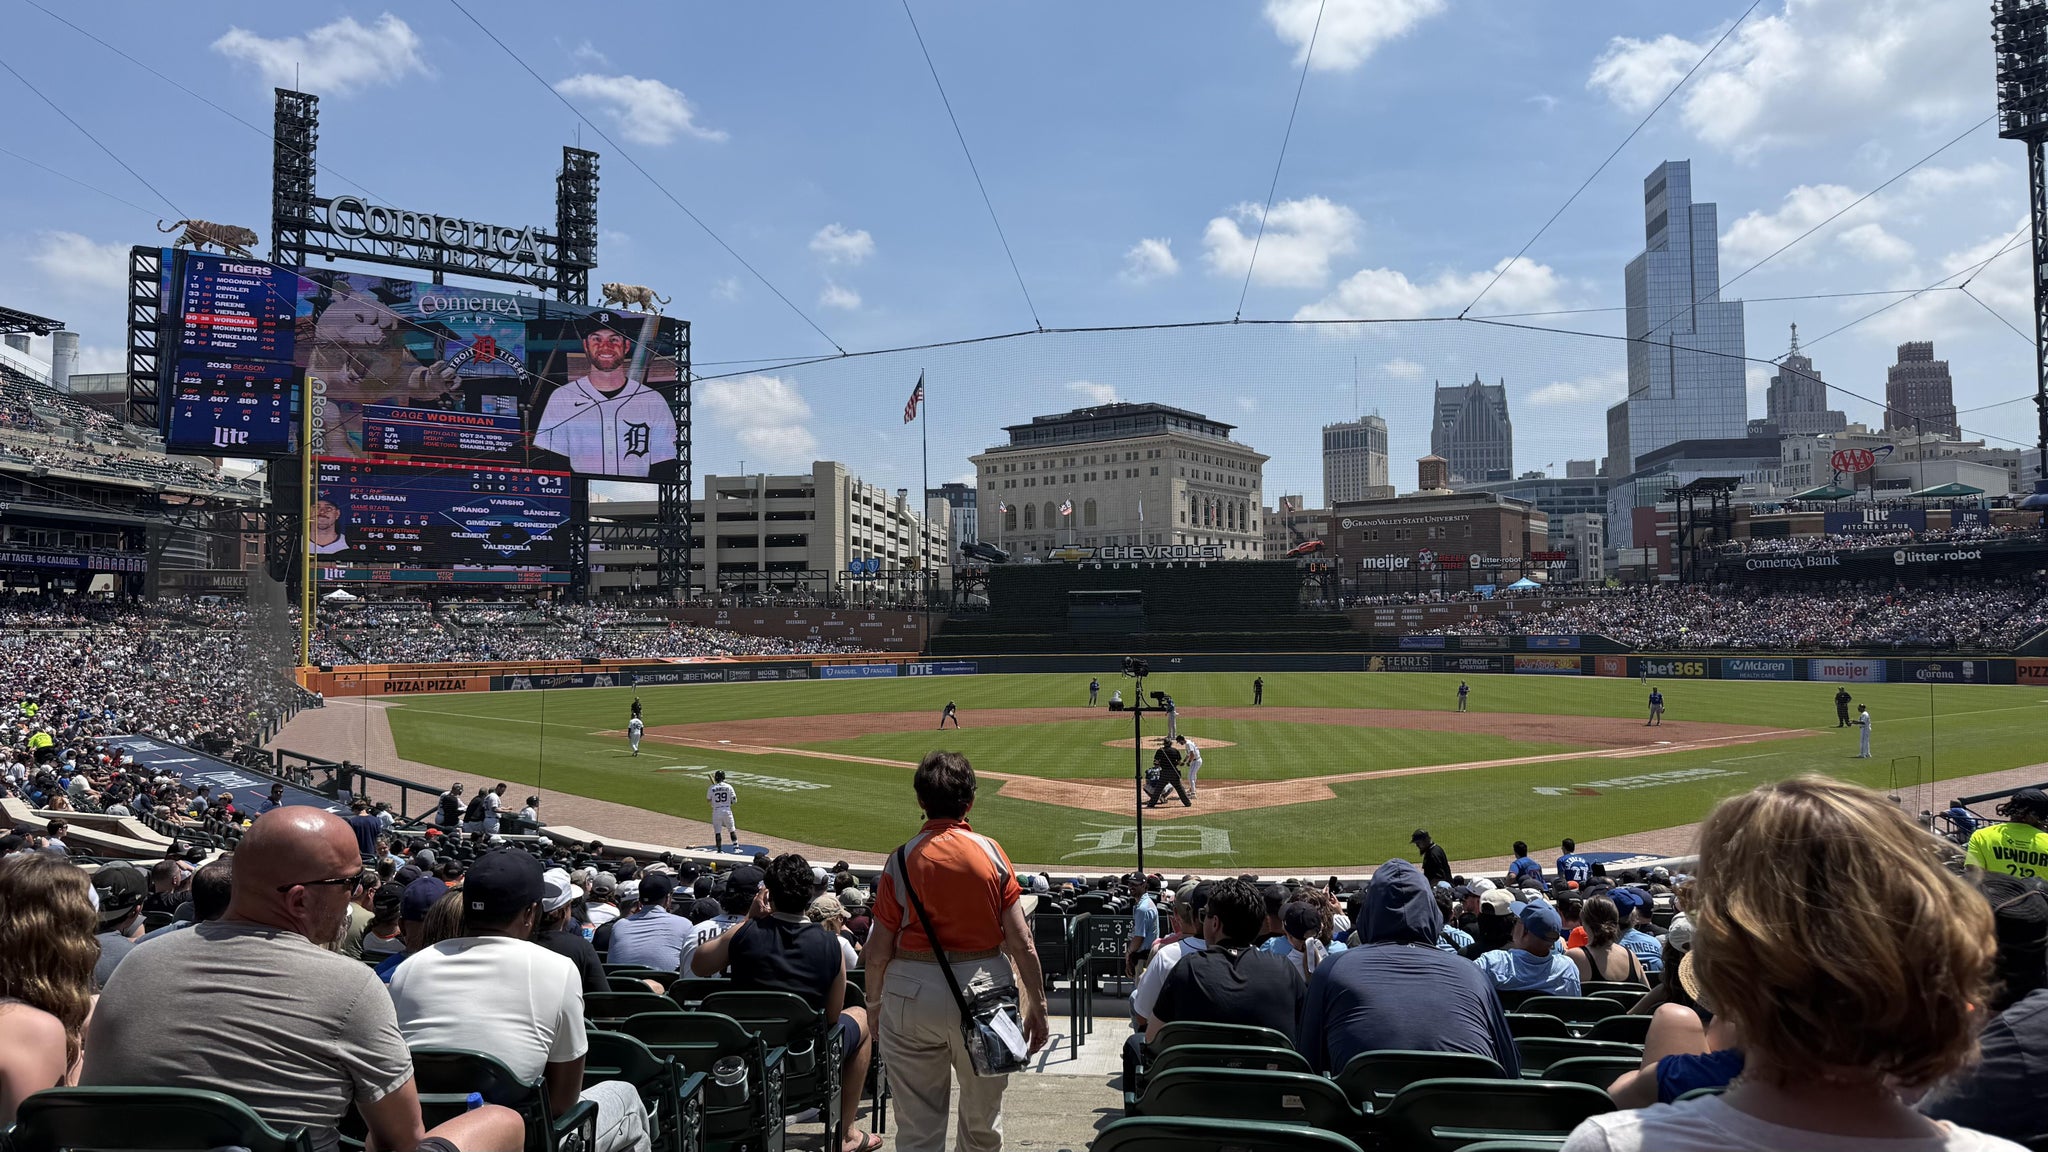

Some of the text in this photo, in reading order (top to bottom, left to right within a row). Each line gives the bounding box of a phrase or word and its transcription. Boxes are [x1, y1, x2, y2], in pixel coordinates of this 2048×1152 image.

[393, 241, 491, 269] PARK
[219, 263, 272, 275] TIGERS
[214, 317, 254, 325] WORKMAN
[450, 316, 496, 324] PARK
[212, 334, 258, 342] TORKELSON
[211, 340, 237, 348] PÉREZ
[233, 364, 266, 372] SEASON
[450, 348, 527, 380] TROIT TIGERS
[392, 410, 494, 426] GAGE WORKMAN
[212, 426, 249, 448] Lite
[1834, 450, 1871, 472] AAA
[538, 476, 562, 486] 0-1
[362, 494, 406, 502] GAUSMAN
[1424, 515, 1470, 523] UNIVERSITY
[1862, 508, 1889, 523] Lite
[1963, 513, 1978, 522] Lite
[1100, 544, 1226, 559] CHEVROLET
[0, 553, 80, 566] AT TASTE. 96 CALORIES.
[1364, 554, 1410, 572] meijer
[1544, 560, 1567, 569] LAW
[1806, 554, 1840, 567] Bank
[1078, 562, 1207, 570] FOUNTAIN
[324, 568, 346, 580] Lite
[213, 576, 248, 586] MARKET
[1506, 602, 1513, 610] 11
[1541, 600, 1552, 608] 42
[794, 610, 799, 618] 5
[810, 626, 819, 634] 47
[891, 628, 895, 636] 1
[1388, 656, 1429, 666] FERRIS
[1520, 658, 1554, 669] Surfside
[1744, 661, 1785, 671] McLaren
[910, 665, 932, 675] DTE
[1647, 661, 1704, 675] bet365
[1824, 662, 1869, 679] meijer
[643, 674, 678, 682] BETMGM
[688, 672, 722, 680] BETMGM
[1916, 669, 1954, 680] Corona
[384, 680, 466, 693] PIZZA! PIZZA!
[714, 792, 728, 803] 39
[1992, 846, 2048, 867] VENDOR
[1115, 924, 1122, 935] 3
[1098, 942, 1116, 953] 4-5
[1625, 942, 1661, 954] RINGER
